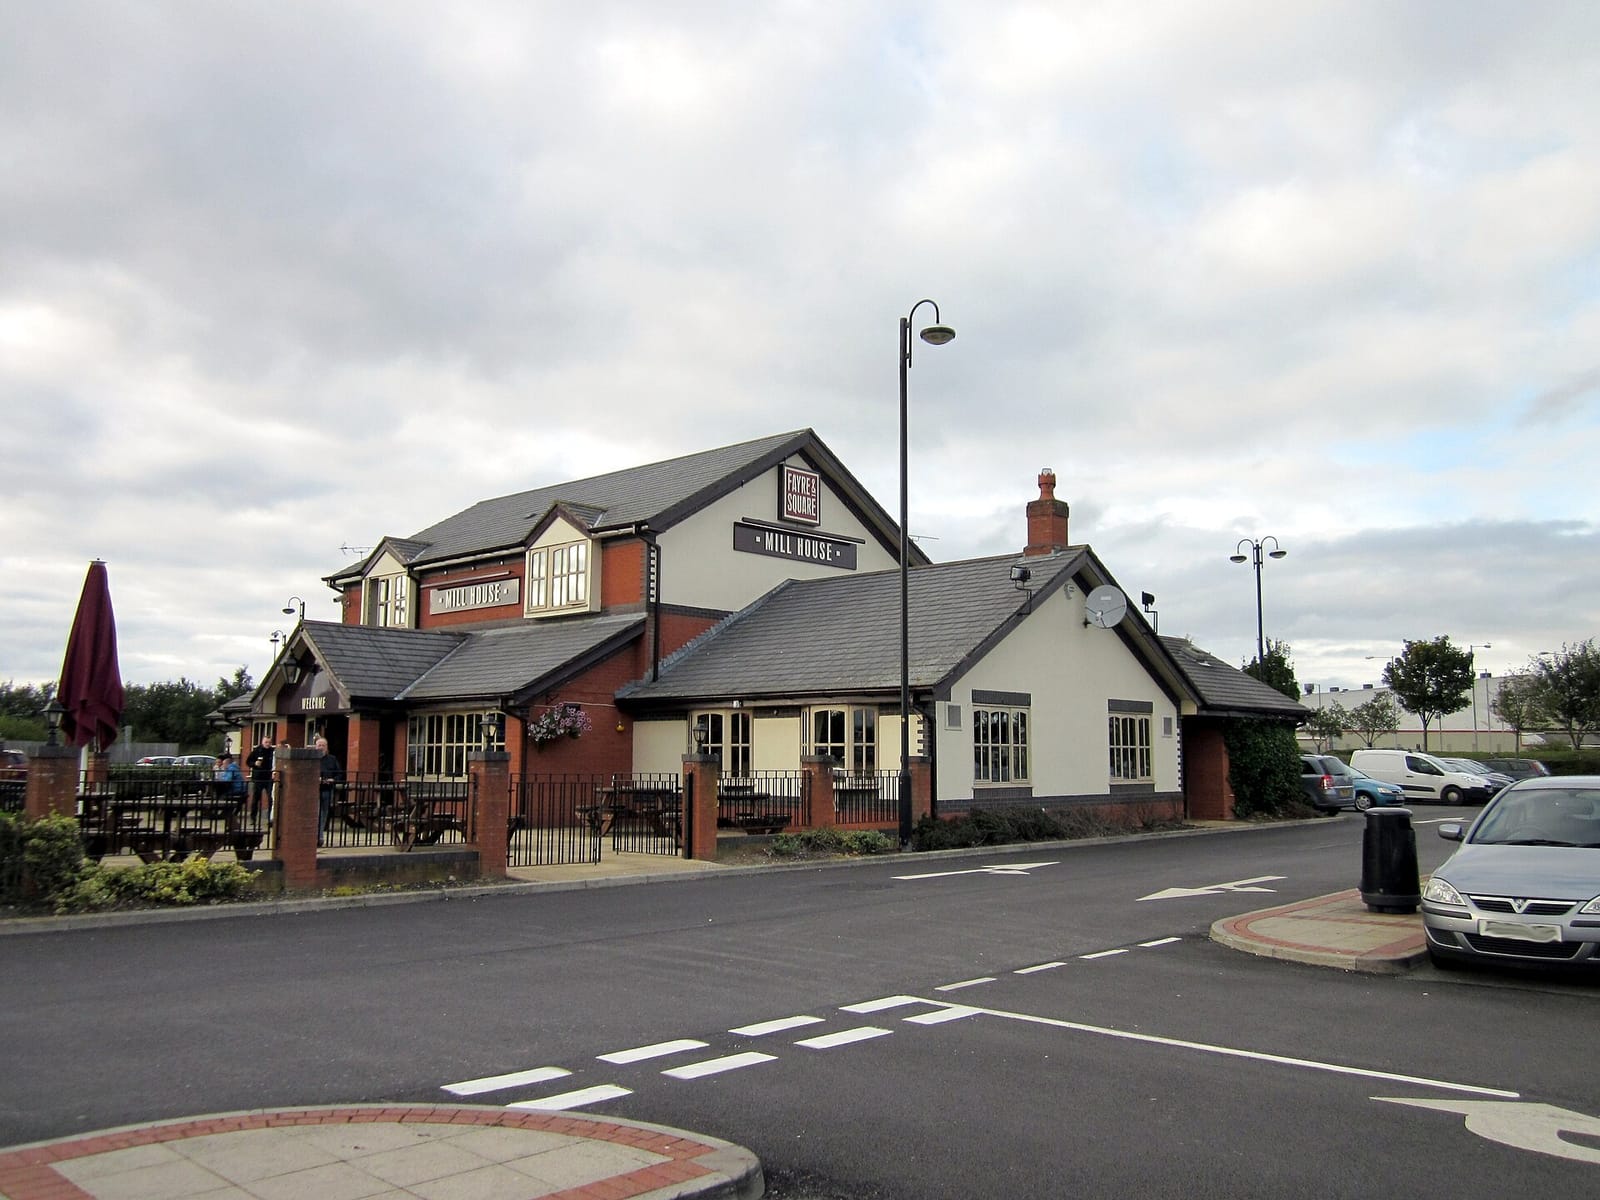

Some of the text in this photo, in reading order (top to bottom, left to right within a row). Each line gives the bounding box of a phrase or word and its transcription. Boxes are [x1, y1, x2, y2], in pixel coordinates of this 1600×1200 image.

[787, 472, 811, 496] FAYRE
[787, 492, 816, 516] SQUARE
[765, 531, 833, 561] MILL HOUSE
[445, 583, 501, 609] MILL HOUSE
